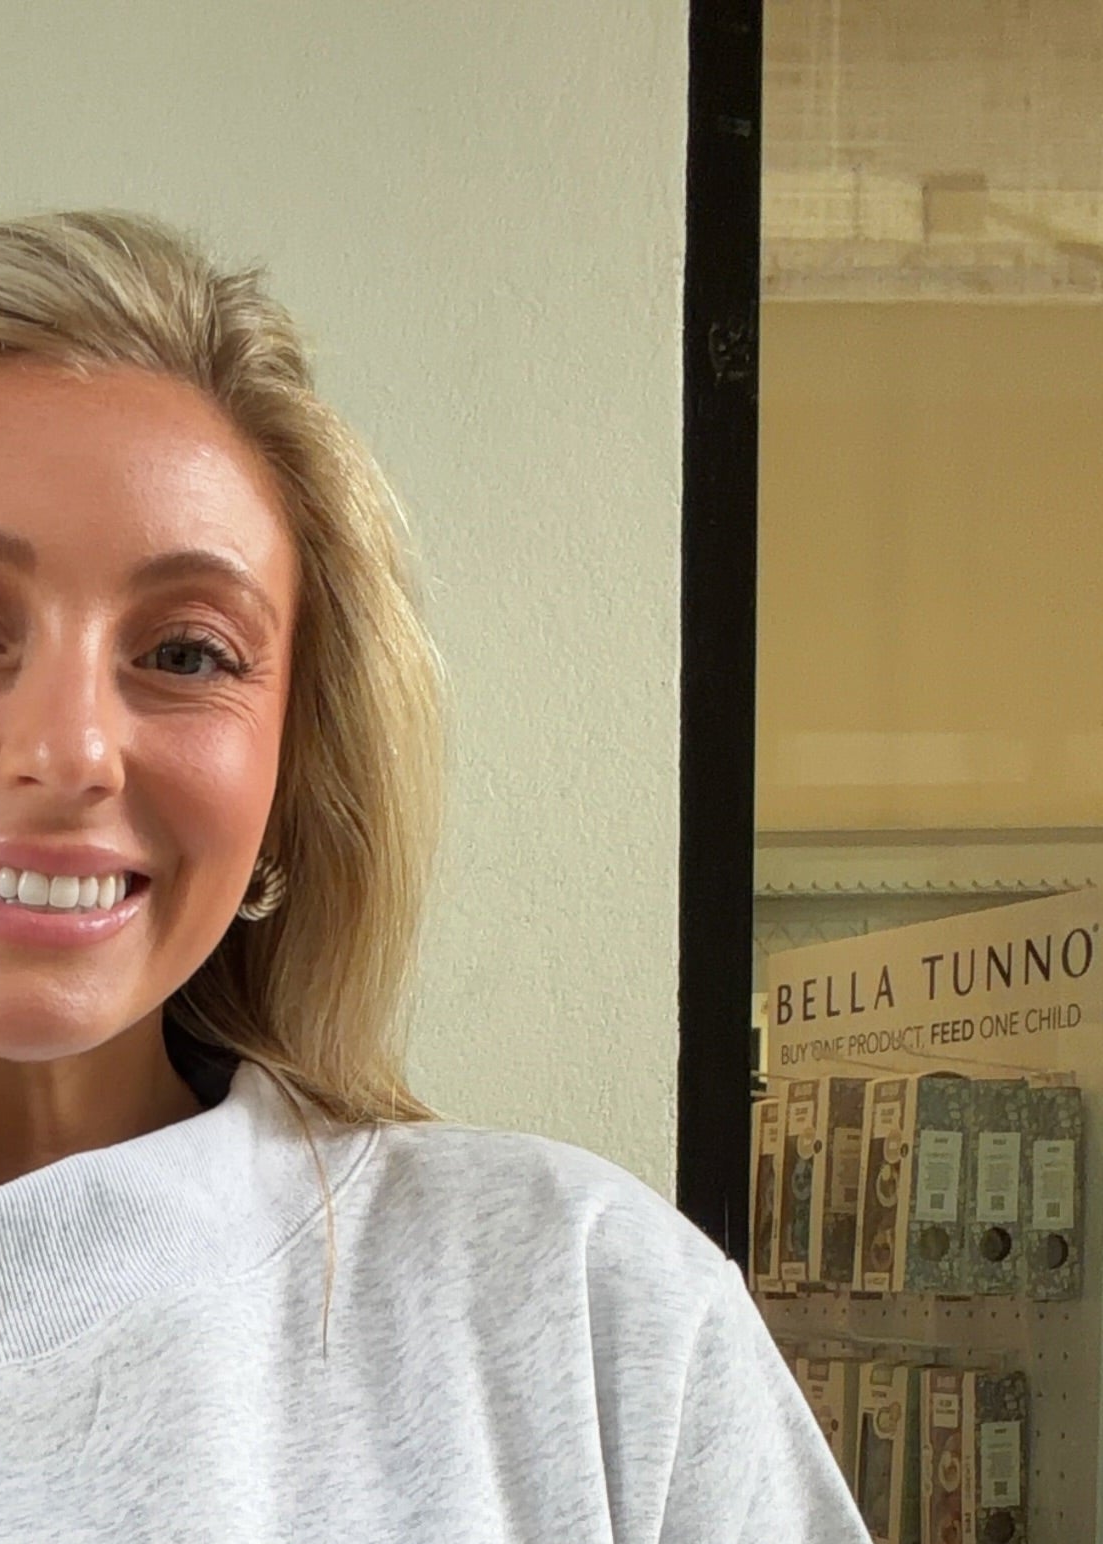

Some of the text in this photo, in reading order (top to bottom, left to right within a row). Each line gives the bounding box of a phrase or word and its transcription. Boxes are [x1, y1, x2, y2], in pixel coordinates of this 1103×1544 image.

[776, 963, 895, 1026] BELLA
[781, 1043, 808, 1066] BUY
[810, 1035, 845, 1062] ONE
[930, 1018, 975, 1045] FEED
[979, 1010, 1020, 1040] ONE
[1024, 1003, 1082, 1034] CHILD
